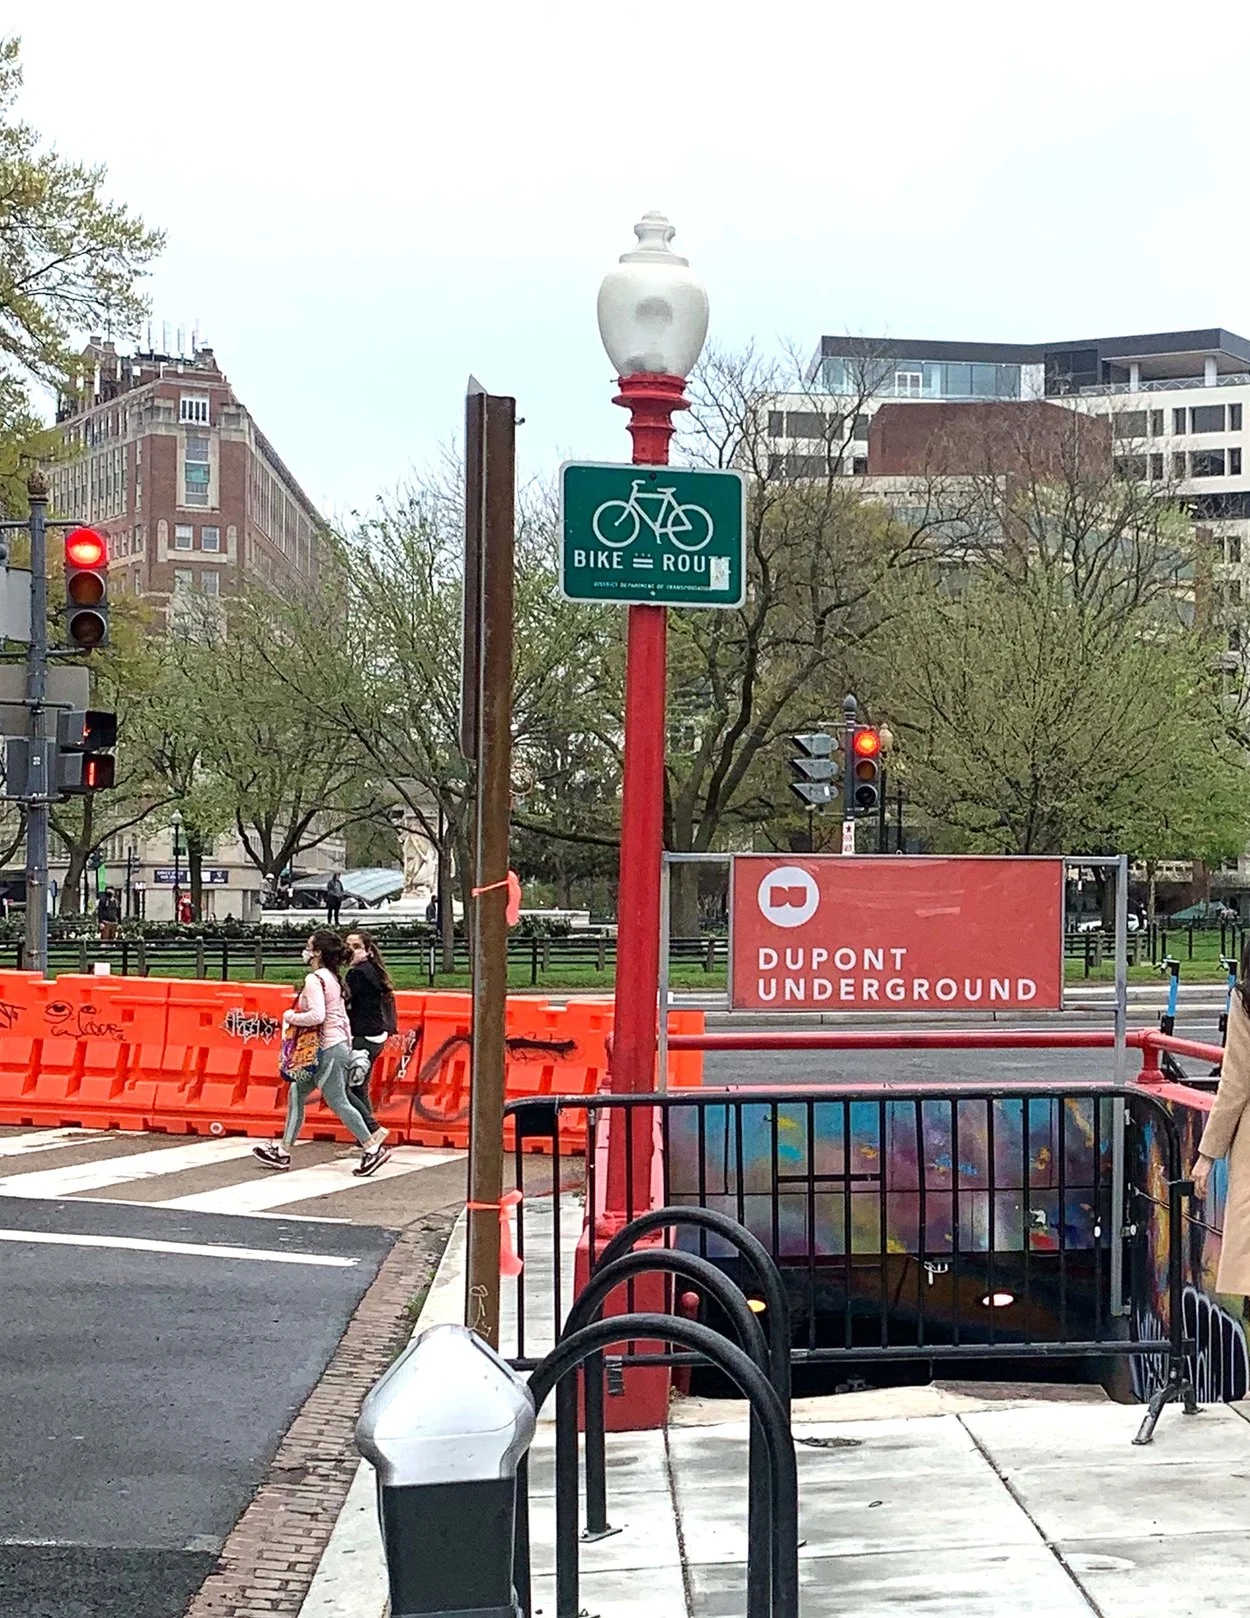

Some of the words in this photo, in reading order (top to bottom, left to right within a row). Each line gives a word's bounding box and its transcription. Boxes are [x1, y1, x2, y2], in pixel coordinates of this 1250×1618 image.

[574, 550, 624, 569] BIKE
[662, 553, 732, 574] ROU
[758, 947, 908, 971] DUPONT
[757, 977, 1038, 1001] UNDERGROUND
